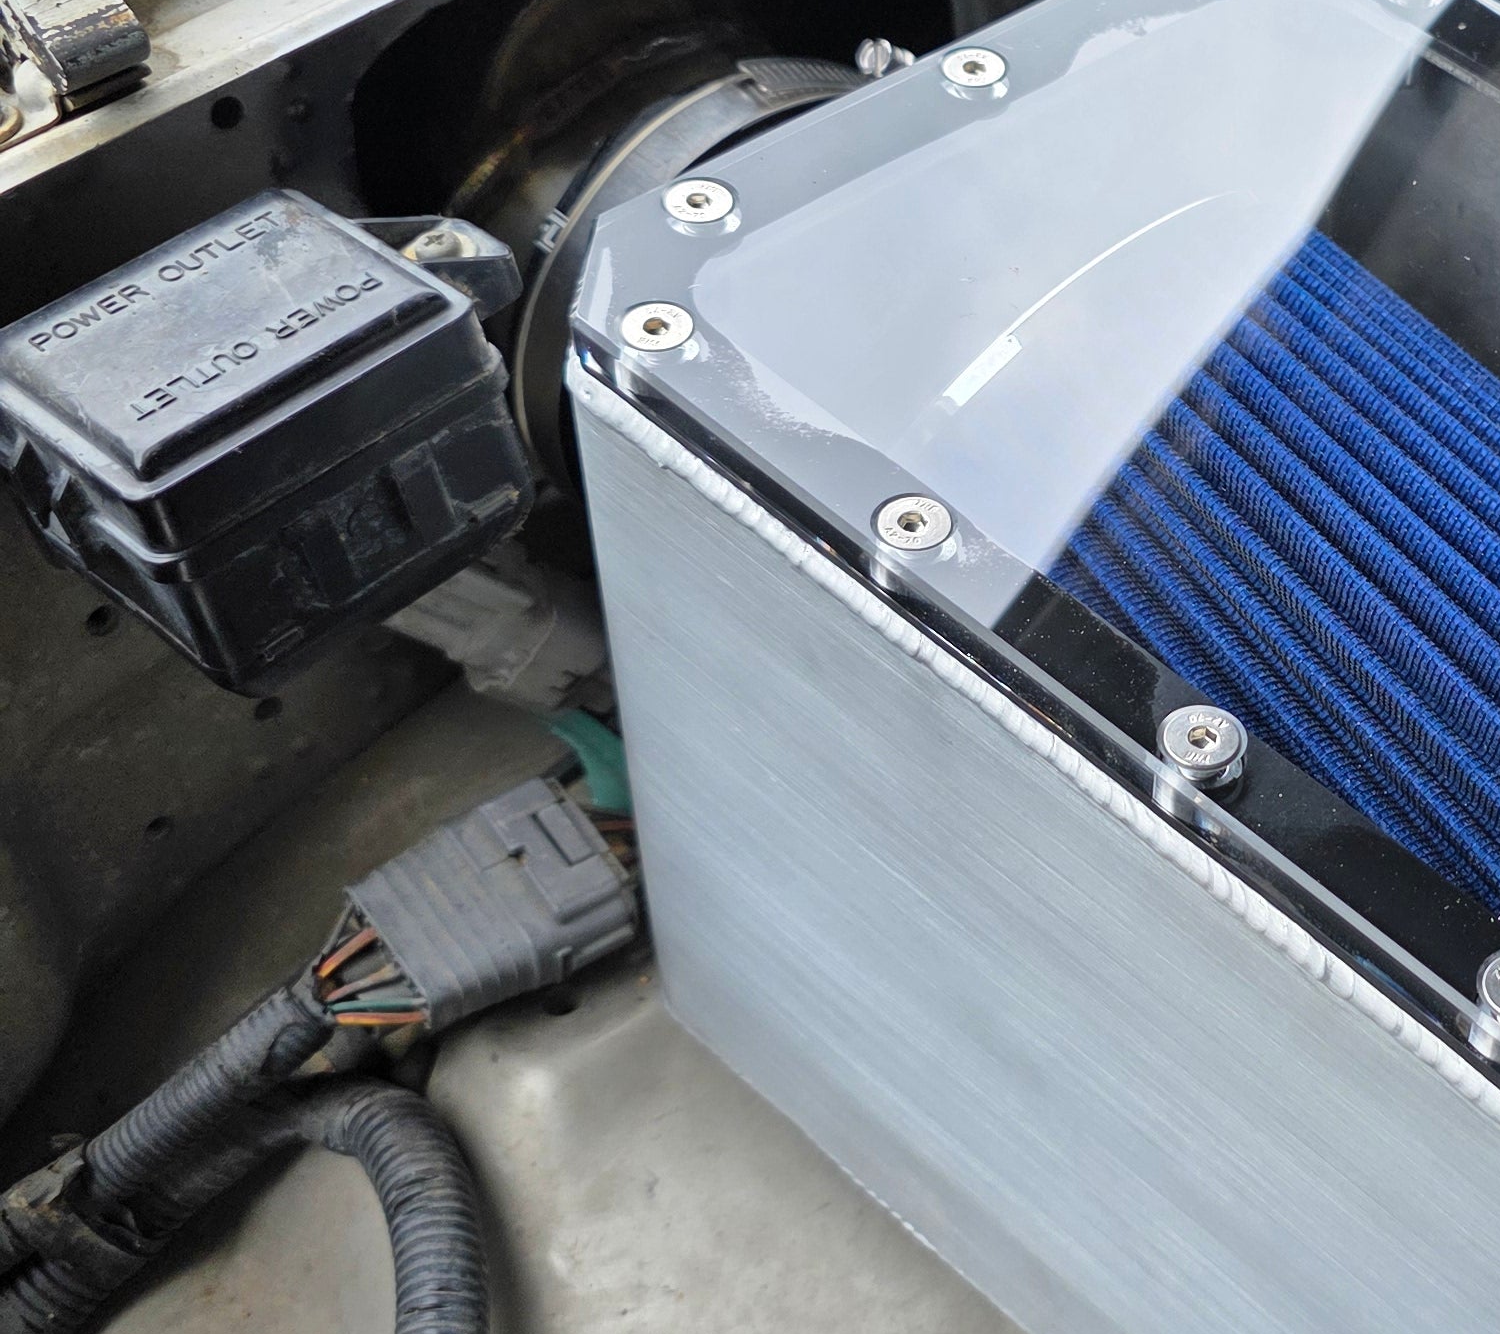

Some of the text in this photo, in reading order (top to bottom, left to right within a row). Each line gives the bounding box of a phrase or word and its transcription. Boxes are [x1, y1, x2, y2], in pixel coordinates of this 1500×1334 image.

[28, 210, 281, 353] POWER OUTLET
[130, 271, 384, 422] POWER OUTLET
